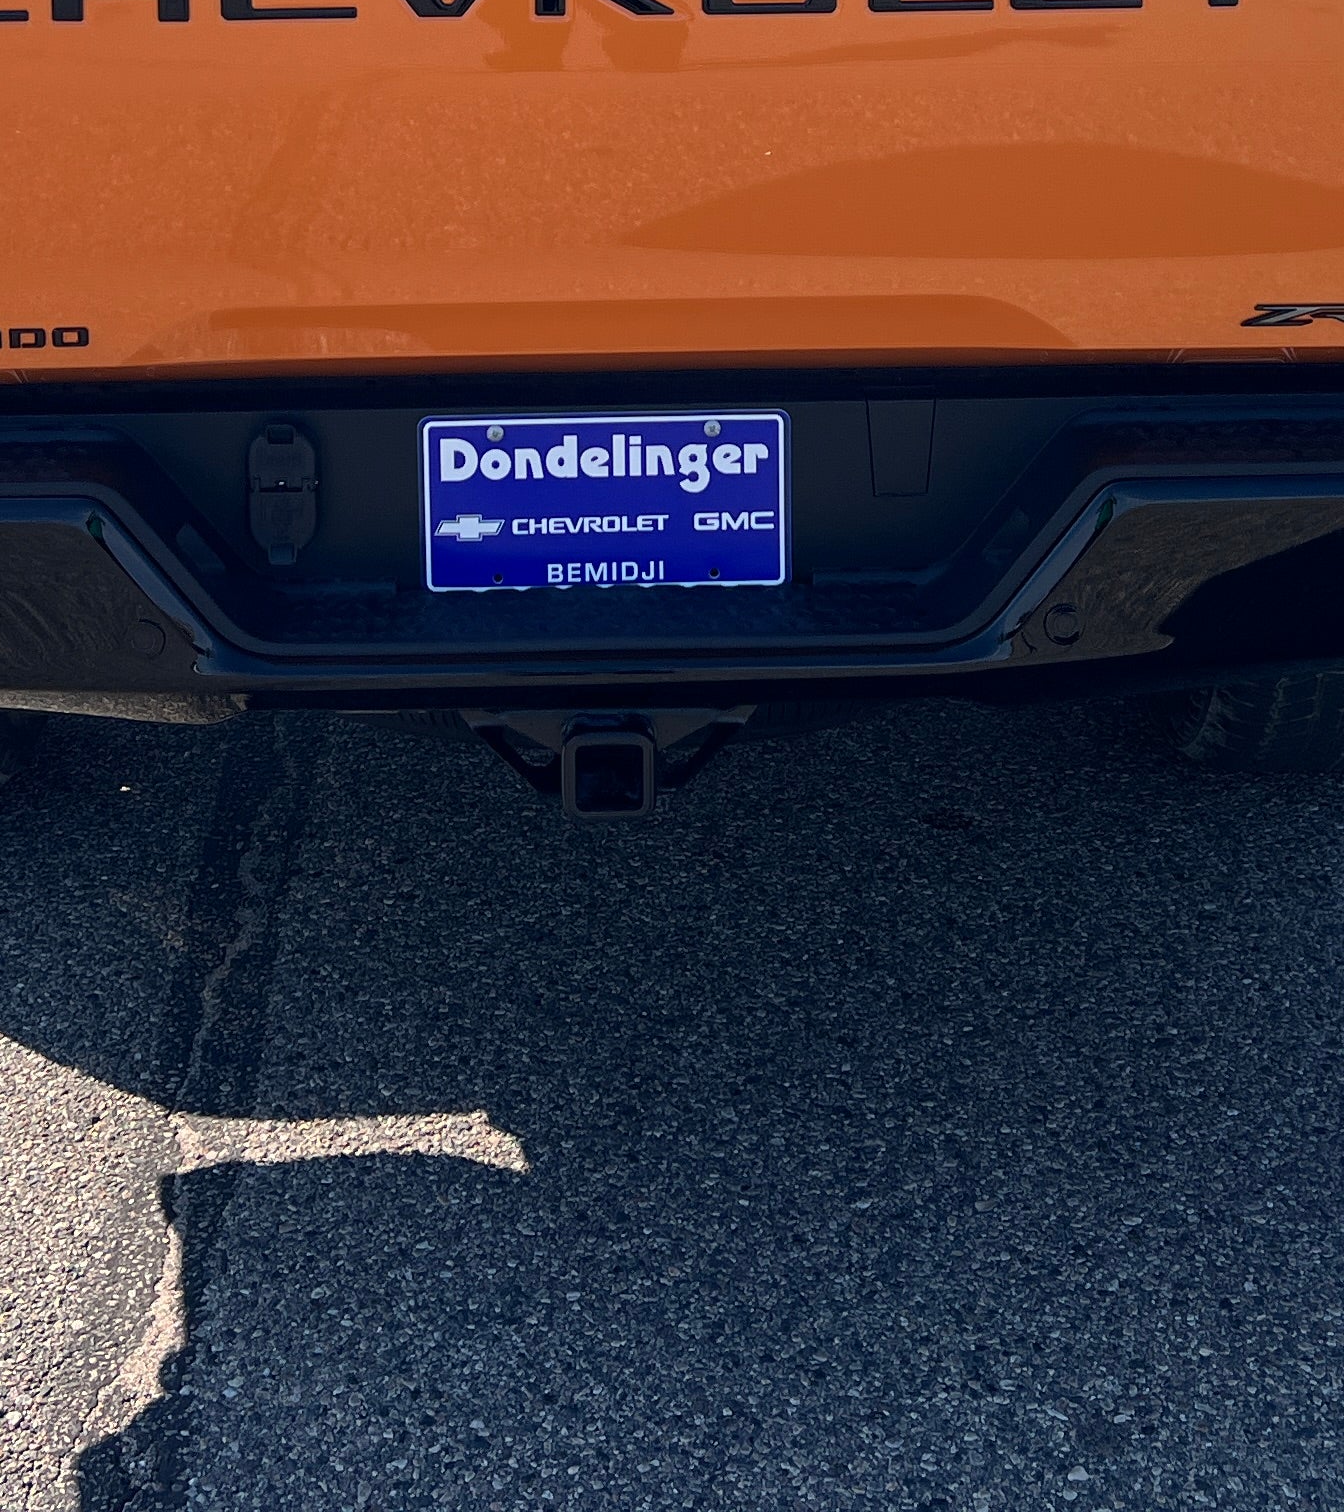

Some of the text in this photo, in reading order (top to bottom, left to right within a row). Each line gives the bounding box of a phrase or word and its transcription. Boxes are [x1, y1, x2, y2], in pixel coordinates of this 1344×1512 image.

[439, 433, 769, 494] Dondelinger
[511, 511, 775, 535] CHEVROLET GMC
[546, 561, 665, 584] BEMIDJI
